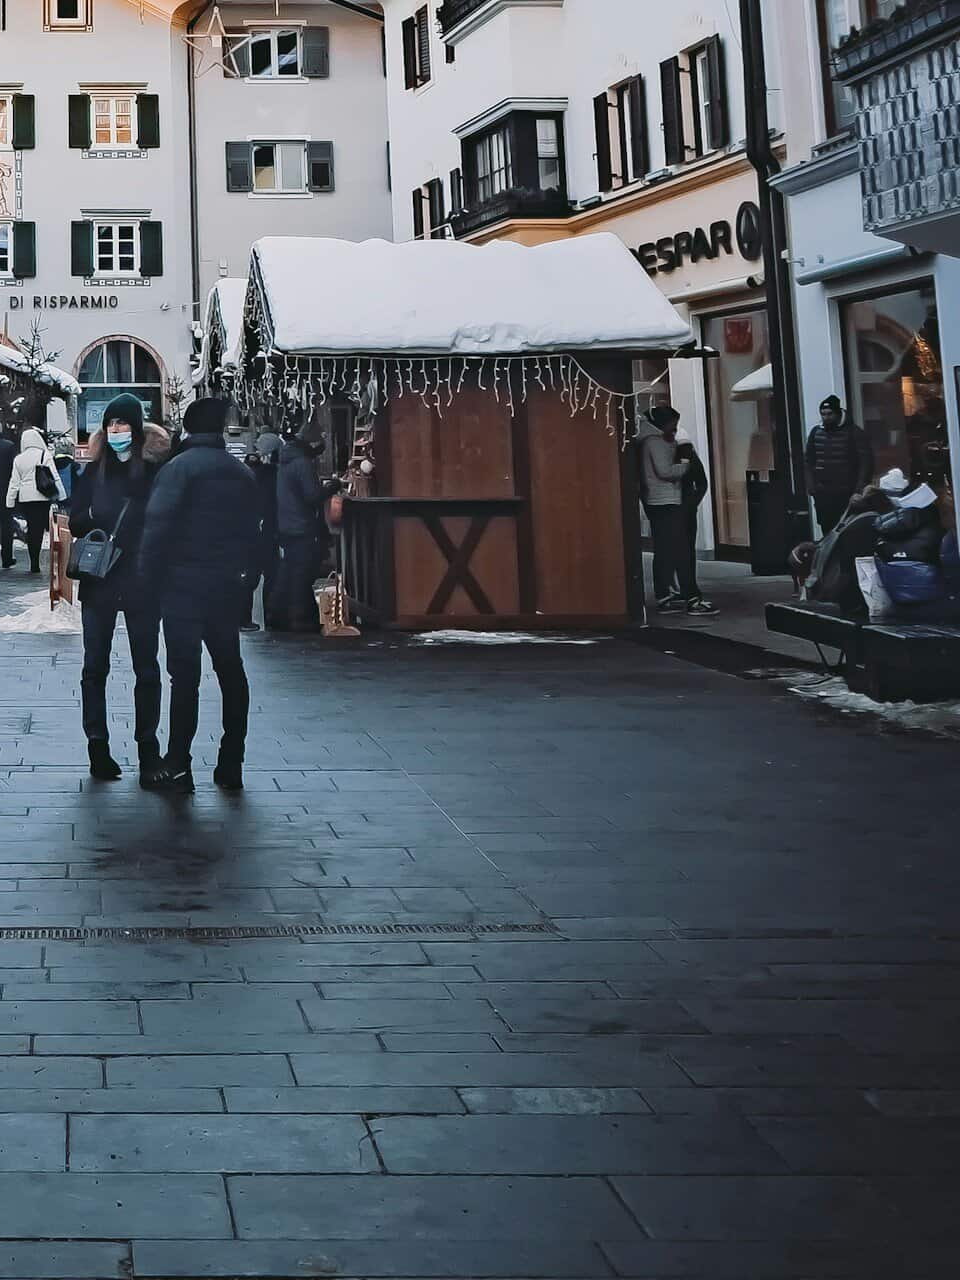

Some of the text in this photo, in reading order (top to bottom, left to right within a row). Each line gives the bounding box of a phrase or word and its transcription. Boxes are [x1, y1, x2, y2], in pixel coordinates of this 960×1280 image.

[630, 220, 734, 275] ESPAR
[9, 296, 24, 309] DI
[33, 295, 119, 310] RISPARMIO
